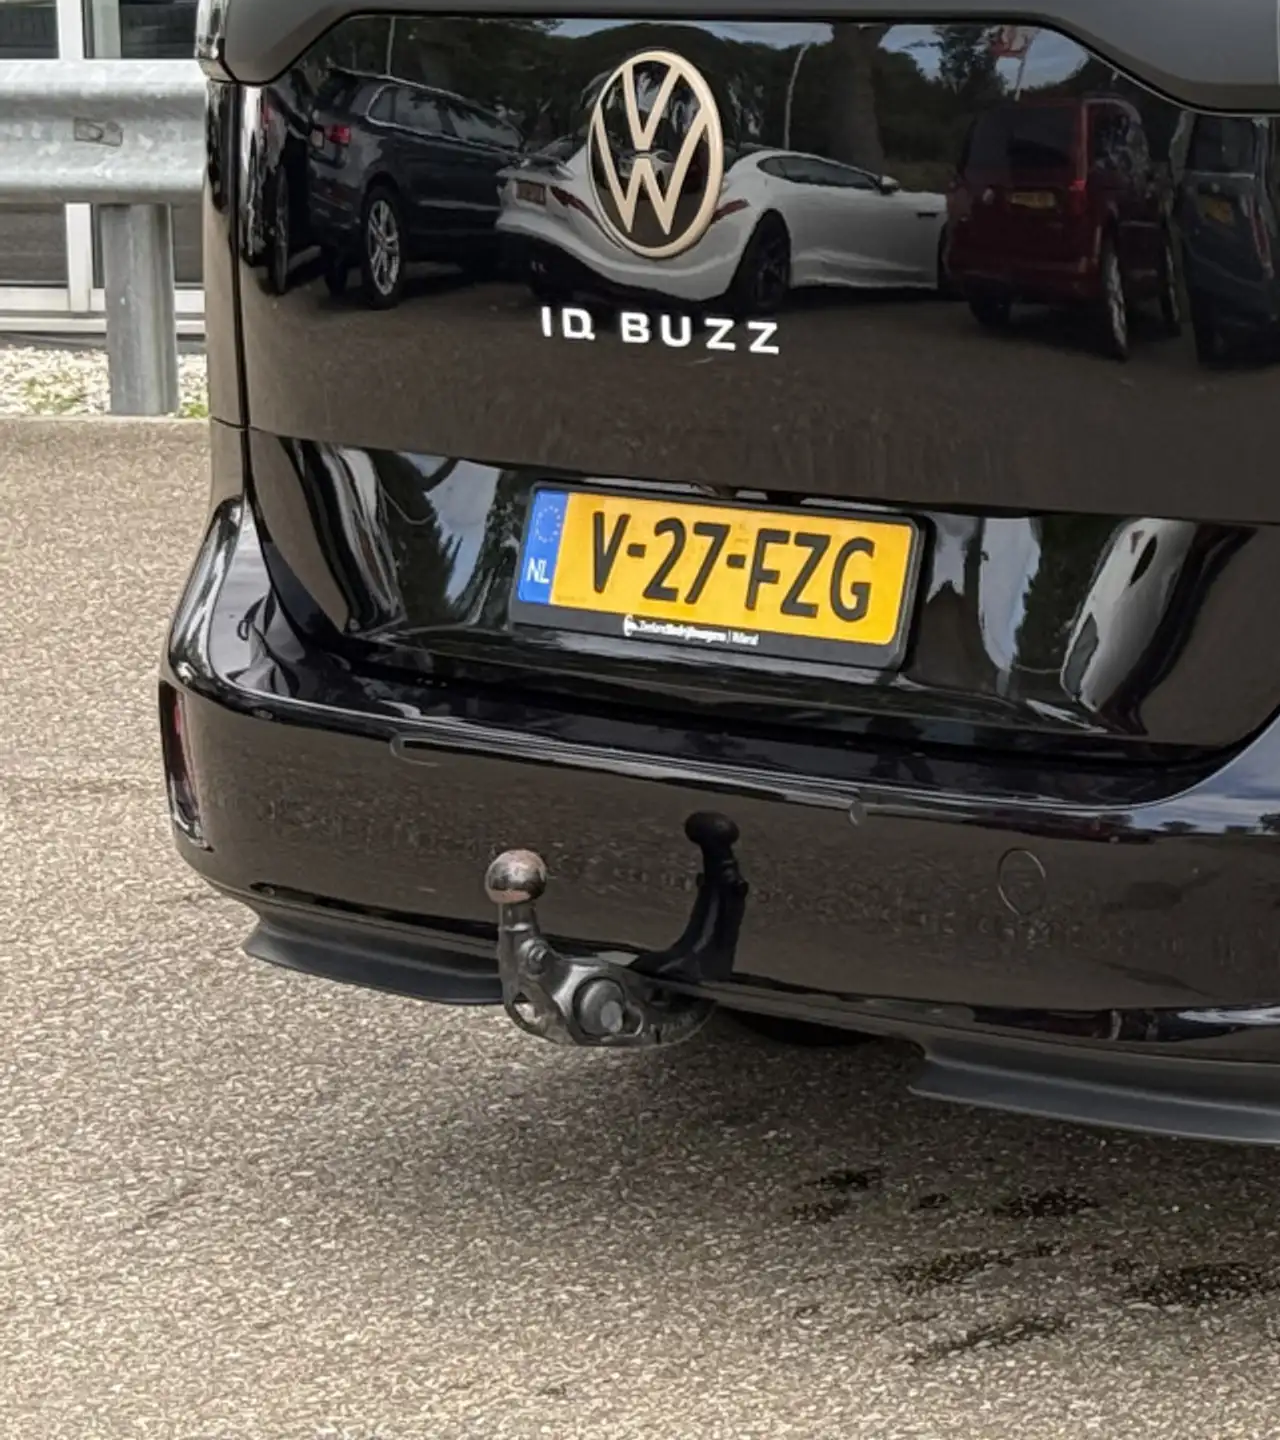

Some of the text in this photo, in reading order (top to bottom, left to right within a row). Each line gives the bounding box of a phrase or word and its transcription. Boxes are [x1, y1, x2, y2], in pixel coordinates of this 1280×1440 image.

[620, 312, 779, 355] BUZZ
[526, 558, 550, 584] NL
[592, 511, 876, 623] V-27-FZG
